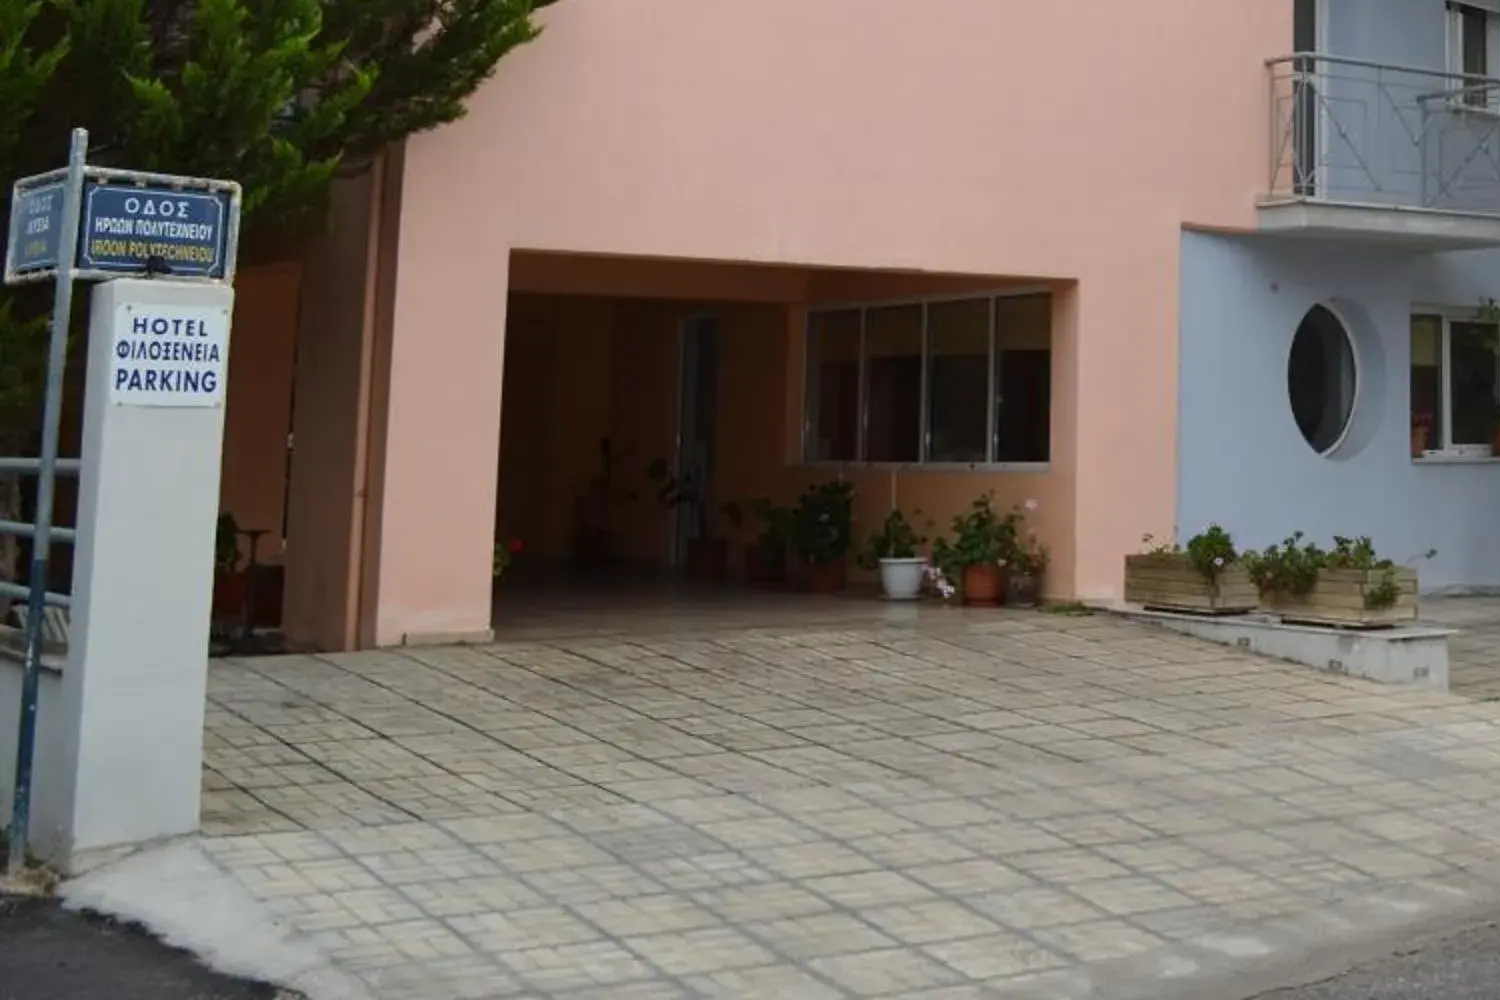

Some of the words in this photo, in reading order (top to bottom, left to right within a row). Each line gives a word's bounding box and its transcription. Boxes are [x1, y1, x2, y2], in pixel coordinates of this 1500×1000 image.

[124, 197, 190, 218] ΟΔΟΣ
[133, 317, 208, 337] HOTEL
[116, 340, 220, 362] ΦΙΛΟΞΕΝΕΙΑ
[115, 368, 217, 393] PARKING
